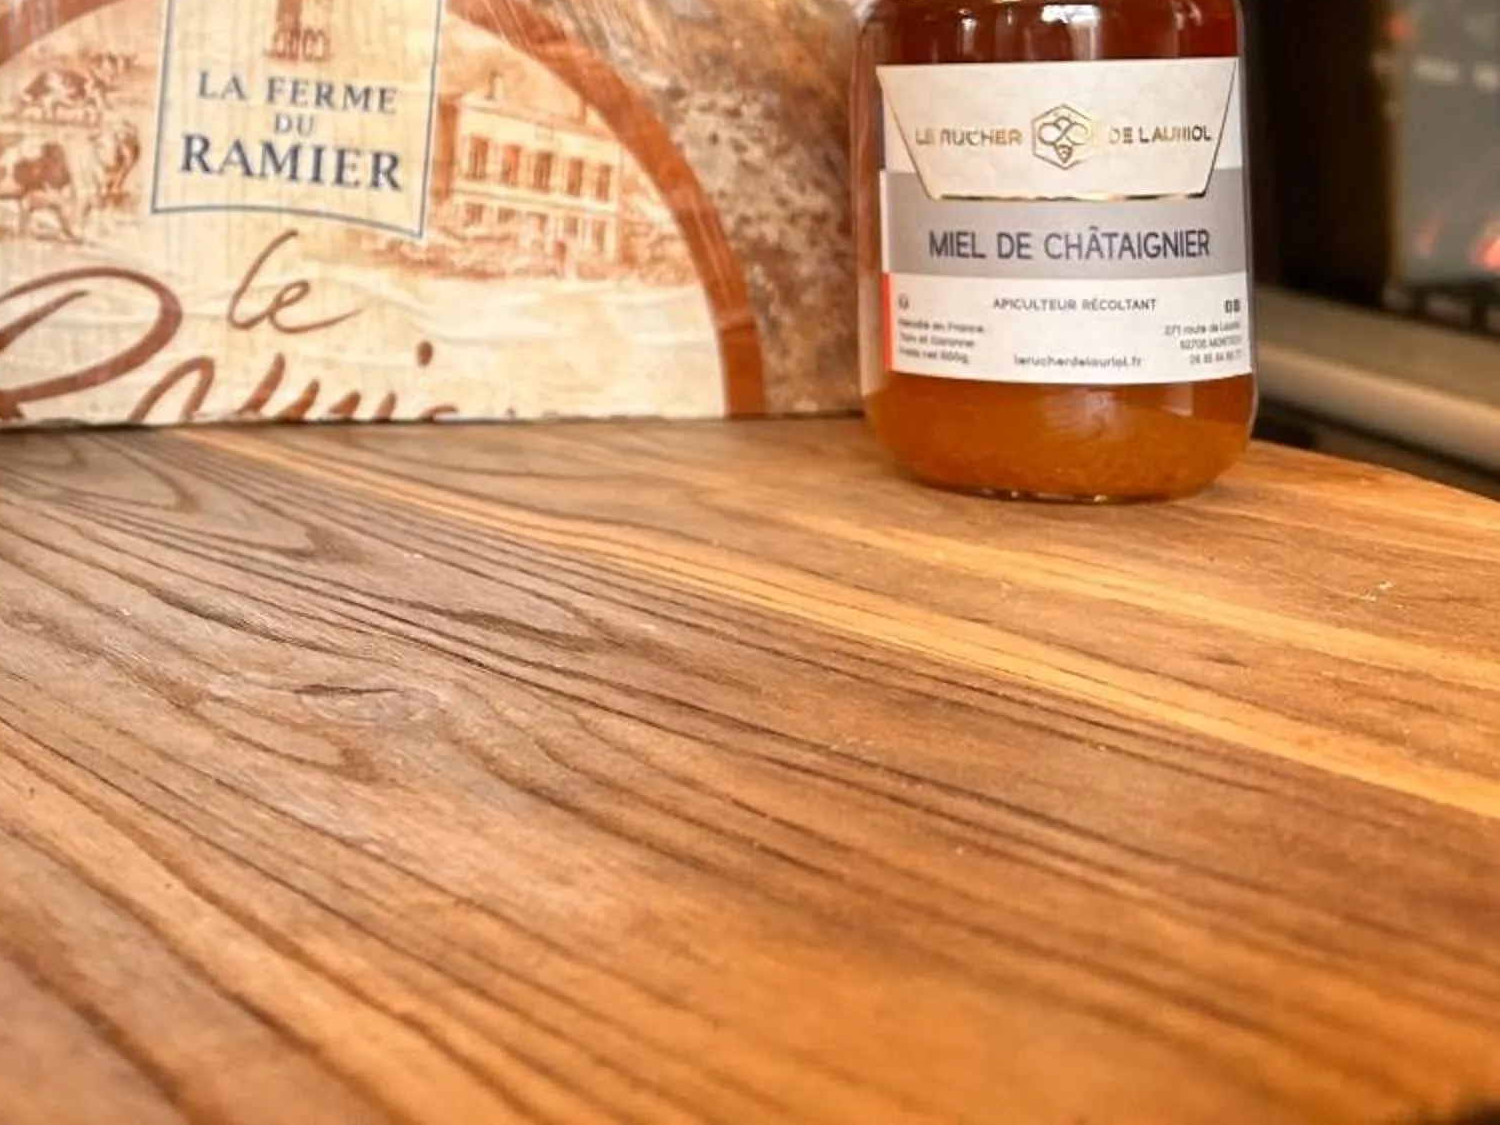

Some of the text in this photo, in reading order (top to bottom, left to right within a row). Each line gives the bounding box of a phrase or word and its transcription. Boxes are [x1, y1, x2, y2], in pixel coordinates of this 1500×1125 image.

[196, 71, 398, 115] LA FERME
[273, 112, 316, 138] DU
[915, 127, 935, 146] LE
[940, 127, 1024, 147] RUCHER
[1108, 127, 1134, 146] DE
[179, 132, 404, 193] RAMIER
[928, 225, 1211, 262] MIEL DE CHÂTAIGNIER
[992, 296, 1157, 313] APICULTEUR RÉCOLTANT
